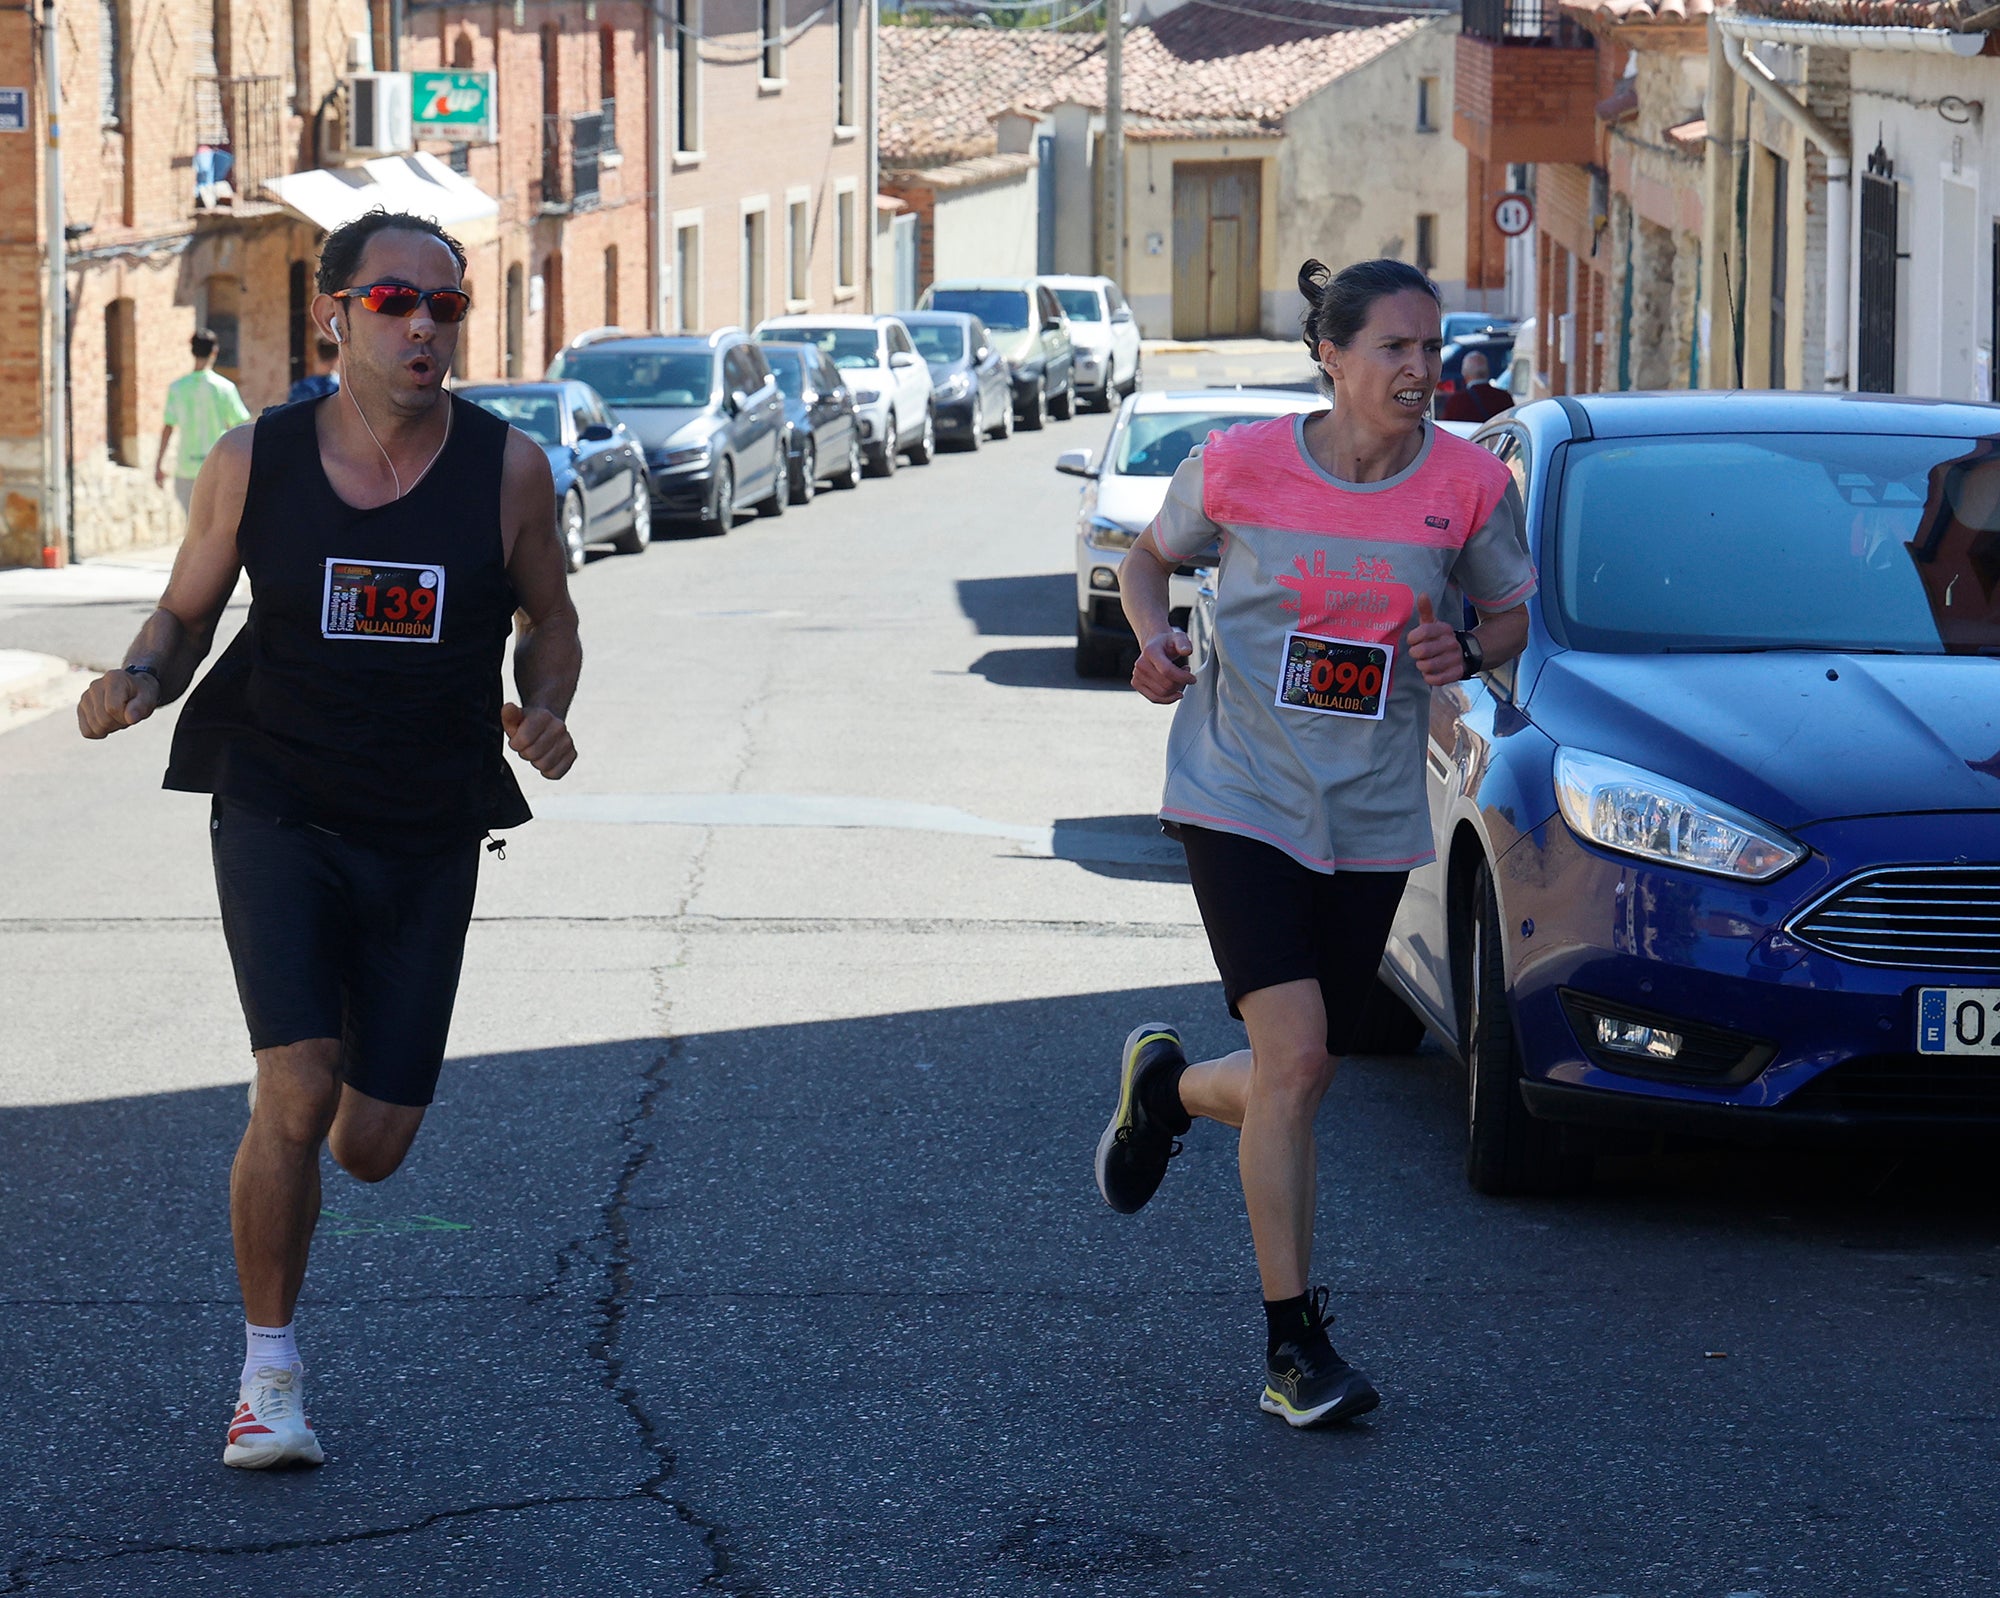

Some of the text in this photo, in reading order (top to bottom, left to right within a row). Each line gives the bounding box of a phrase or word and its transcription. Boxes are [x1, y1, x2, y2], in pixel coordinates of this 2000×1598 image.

[363, 585, 435, 621] 139
[1325, 588, 1389, 609] media
[355, 620, 431, 635] VILLALOBÓN
[1311, 659, 1382, 697] 090
[1927, 1027, 1939, 1041] E
